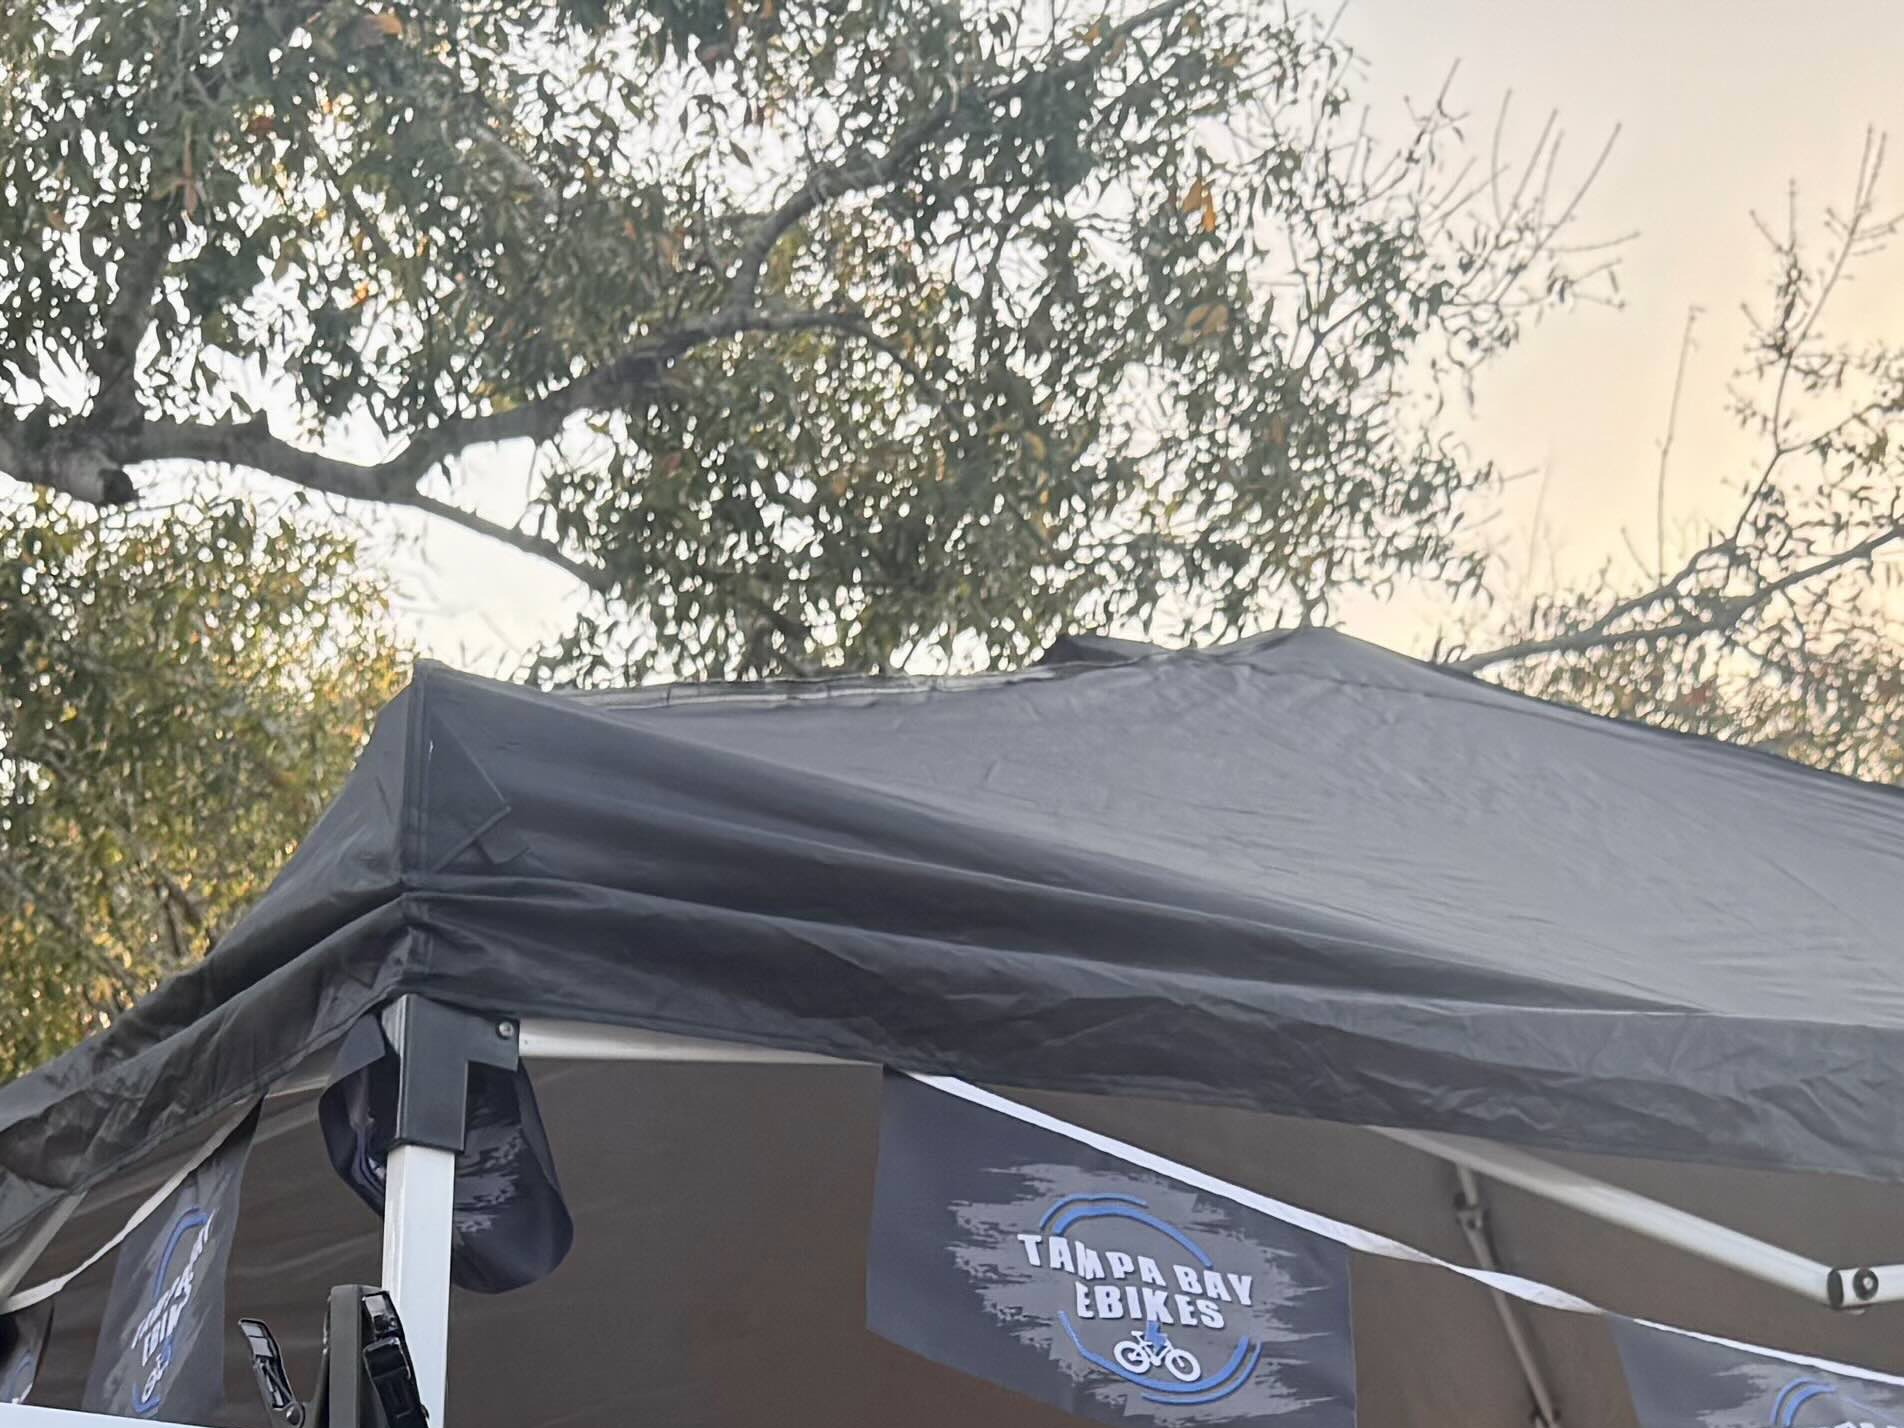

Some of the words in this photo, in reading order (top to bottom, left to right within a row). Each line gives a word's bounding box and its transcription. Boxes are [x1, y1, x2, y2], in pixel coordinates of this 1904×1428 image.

[1017, 1233, 1167, 1287] TAMPA
[1174, 1263, 1253, 1307] BAY
[1075, 1281, 1226, 1329] EBIKES
